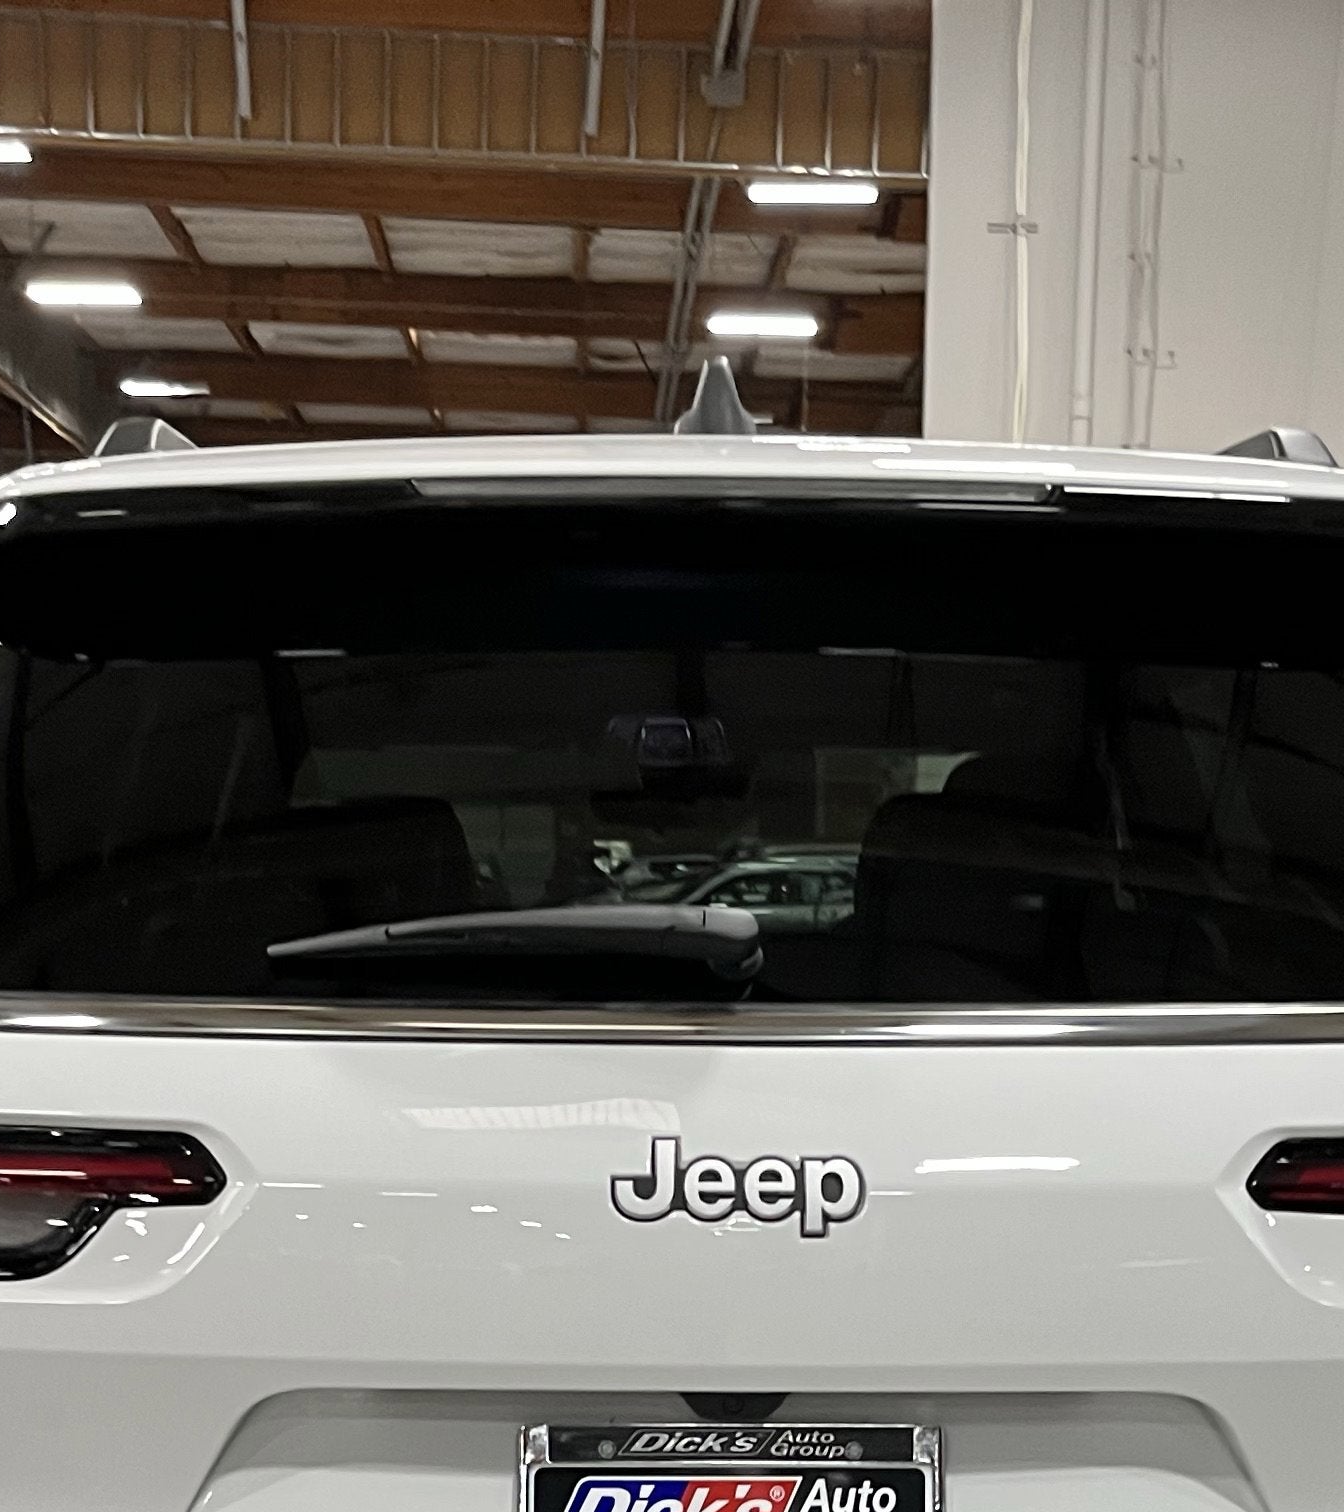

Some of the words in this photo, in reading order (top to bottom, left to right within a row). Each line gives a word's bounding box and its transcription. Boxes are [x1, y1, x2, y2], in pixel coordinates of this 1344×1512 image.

[610, 1136, 867, 1238] Jeep
[777, 1429, 835, 1444] Auto
[771, 1442, 845, 1460] Group
